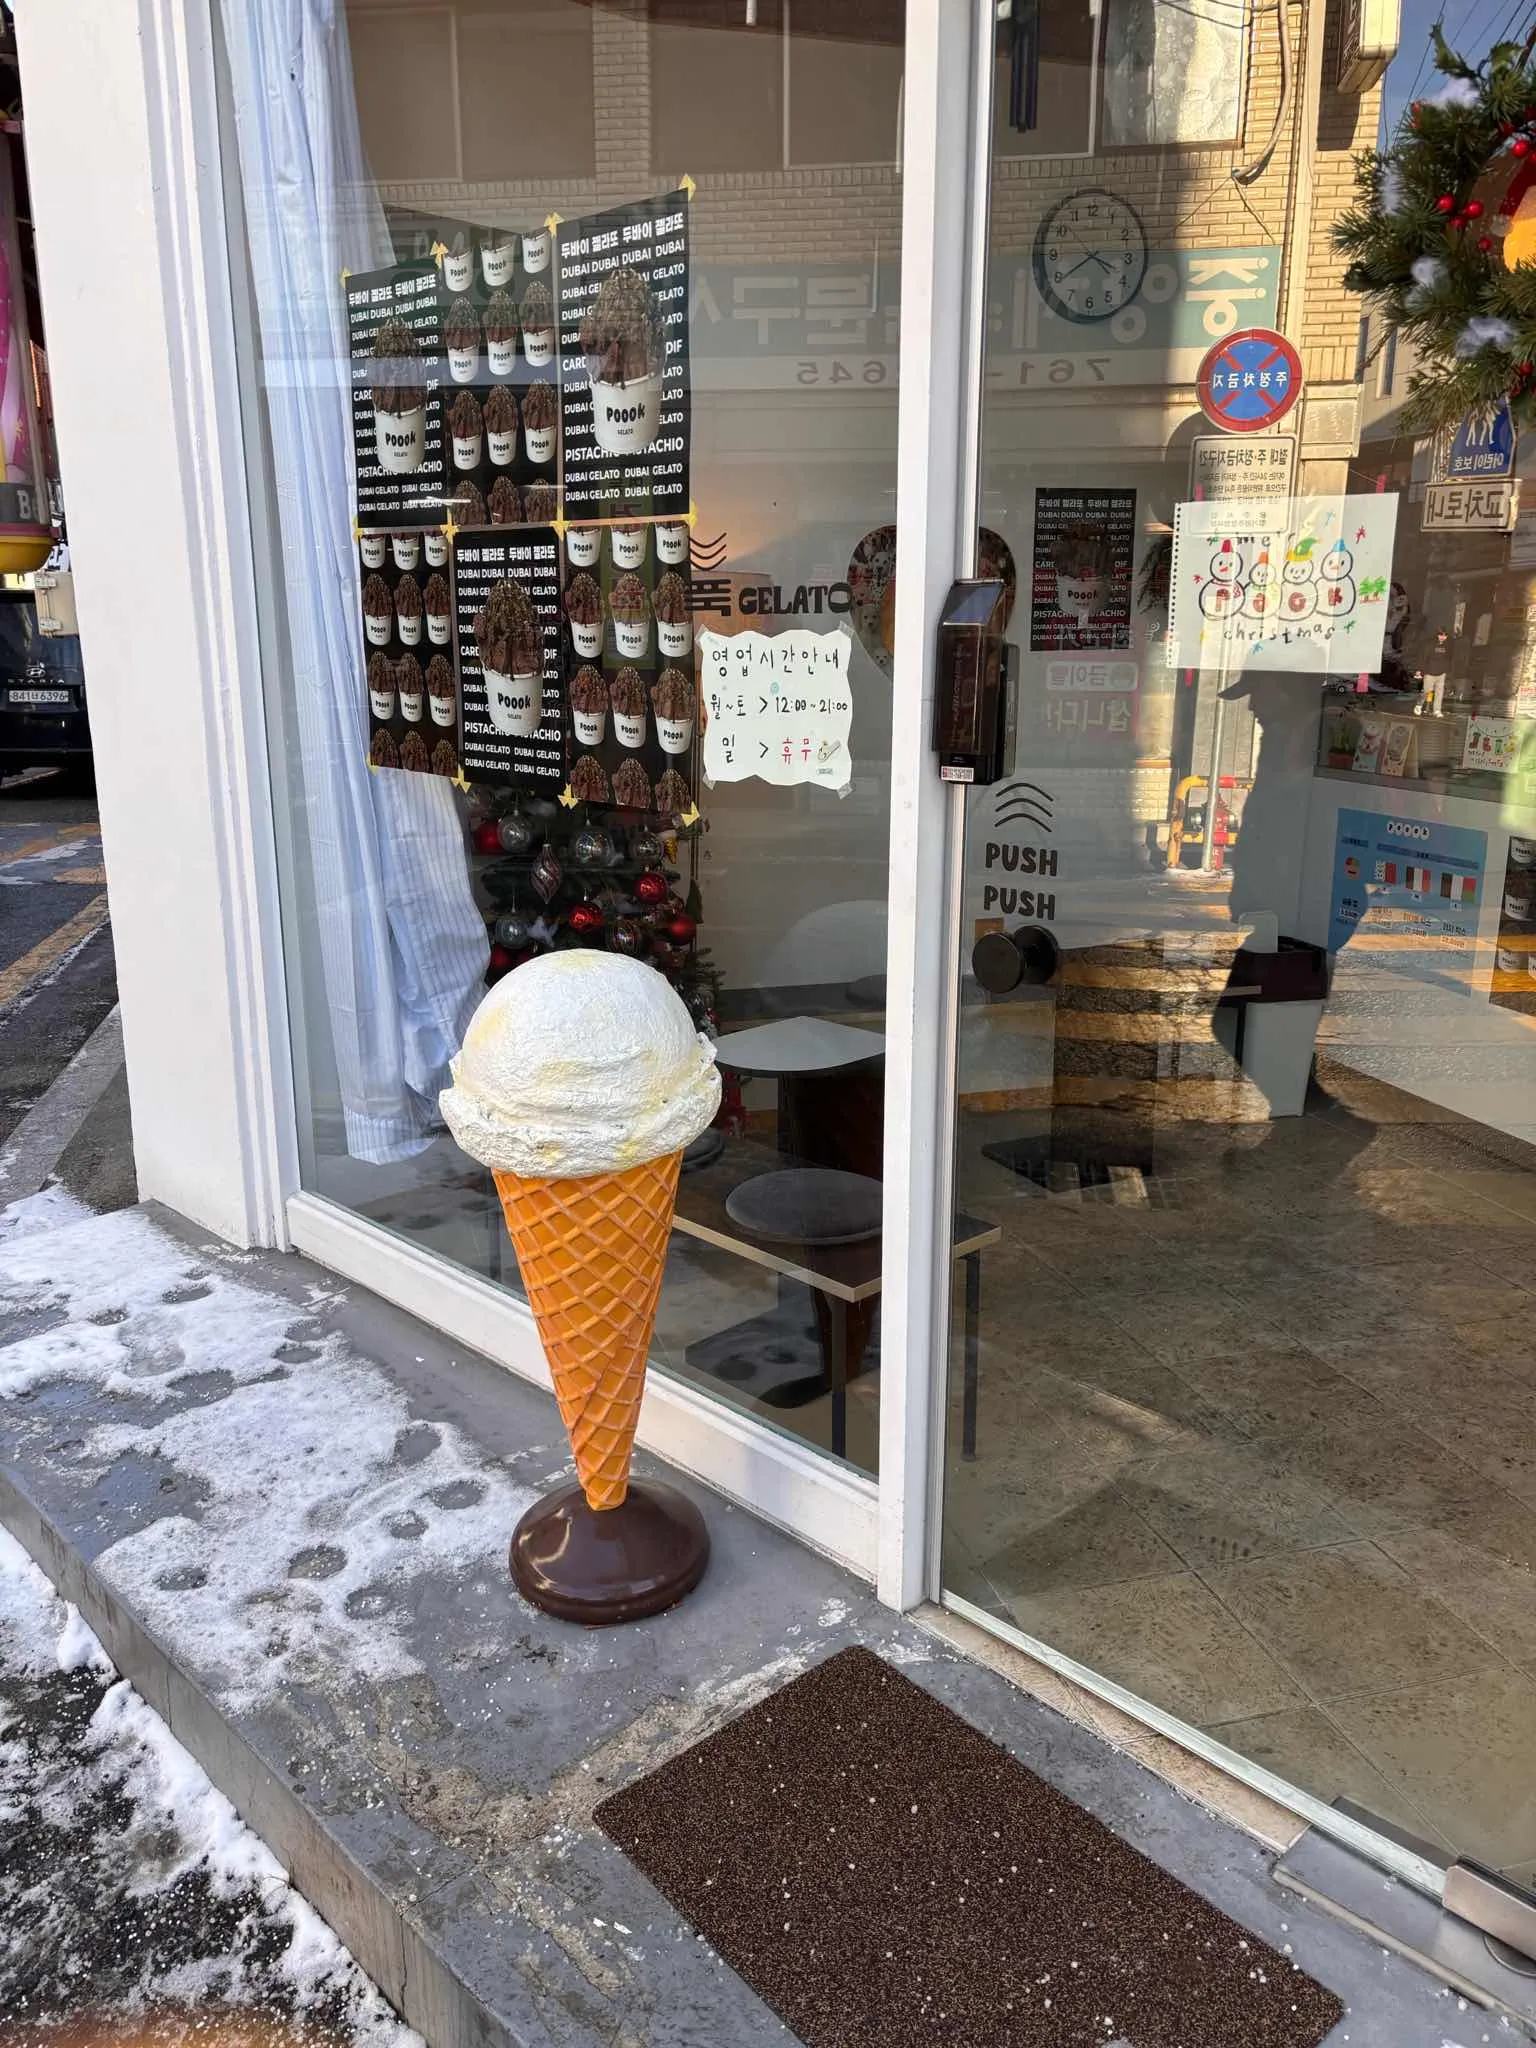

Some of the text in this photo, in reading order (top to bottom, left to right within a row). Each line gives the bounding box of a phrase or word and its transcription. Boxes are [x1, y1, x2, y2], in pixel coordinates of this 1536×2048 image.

[1088, 206, 1098, 217] 12
[561, 212, 684, 259] 두바이 젤라또 두바이 젤라또
[1120, 228, 1129, 240] 2
[561, 238, 684, 279] DUBAI DUBAI DUBAI DUBAI
[1048, 248, 1058, 261] 9
[1124, 252, 1133, 265] 3
[562, 286, 587, 300] DUBAI
[652, 263, 684, 280] GELATO
[1118, 275, 1128, 287] 4
[349, 274, 436, 306] 두바이 젤라또 두바이 젤라또
[1104, 290, 1112, 303] 5
[1086, 296, 1094, 309] 6
[350, 296, 437, 323] DUBAI DUBAI DUBAI DUBAI
[562, 307, 586, 321] DUBAI
[352, 331, 369, 341] DUBAI
[414, 316, 438, 328] GELATO
[351, 349, 370, 358] DUBAI
[564, 382, 588, 393] DUBAI
[355, 410, 373, 420] DUBAI
[564, 403, 588, 414] DUBAI
[606, 402, 646, 423] POOOK
[356, 428, 373, 438] DUBAI
[565, 425, 589, 436] DUBAI
[385, 430, 416, 447] POOOK
[357, 447, 374, 456] DUBAI
[565, 463, 683, 483] DUBAI GELATO DUBAI GELATO
[358, 482, 442, 496] DUBAI GELATO DUBAI GELATO
[565, 484, 683, 502] DUBAI GELATO DUBAI GELATO
[359, 503, 376, 512] DUBAI
[377, 501, 400, 511] GELATO
[402, 500, 418, 510] DUBAI
[457, 545, 556, 562] 두바이 젤라또 두바이 젤라또
[457, 567, 557, 578] DUBAI DUBAI DUBAI DUBAI
[458, 587, 478, 596] DUBAI
[532, 586, 557, 595] GELATO
[738, 582, 852, 615] GELATO
[458, 605, 478, 614] DUBAI
[462, 666, 481, 675] DUBAI
[463, 684, 483, 693] DUBAI
[464, 702, 484, 711] DUBAI
[497, 692, 532, 709] POOOK
[464, 742, 561, 760] DUBAI GELATO DUBAI GELATO
[722, 734, 812, 765] 일 휴무
[465, 758, 560, 777] DUBAI GELATO DUBAI GELATO
[985, 842, 1059, 877] PUSH
[983, 885, 1056, 921] PUSH
